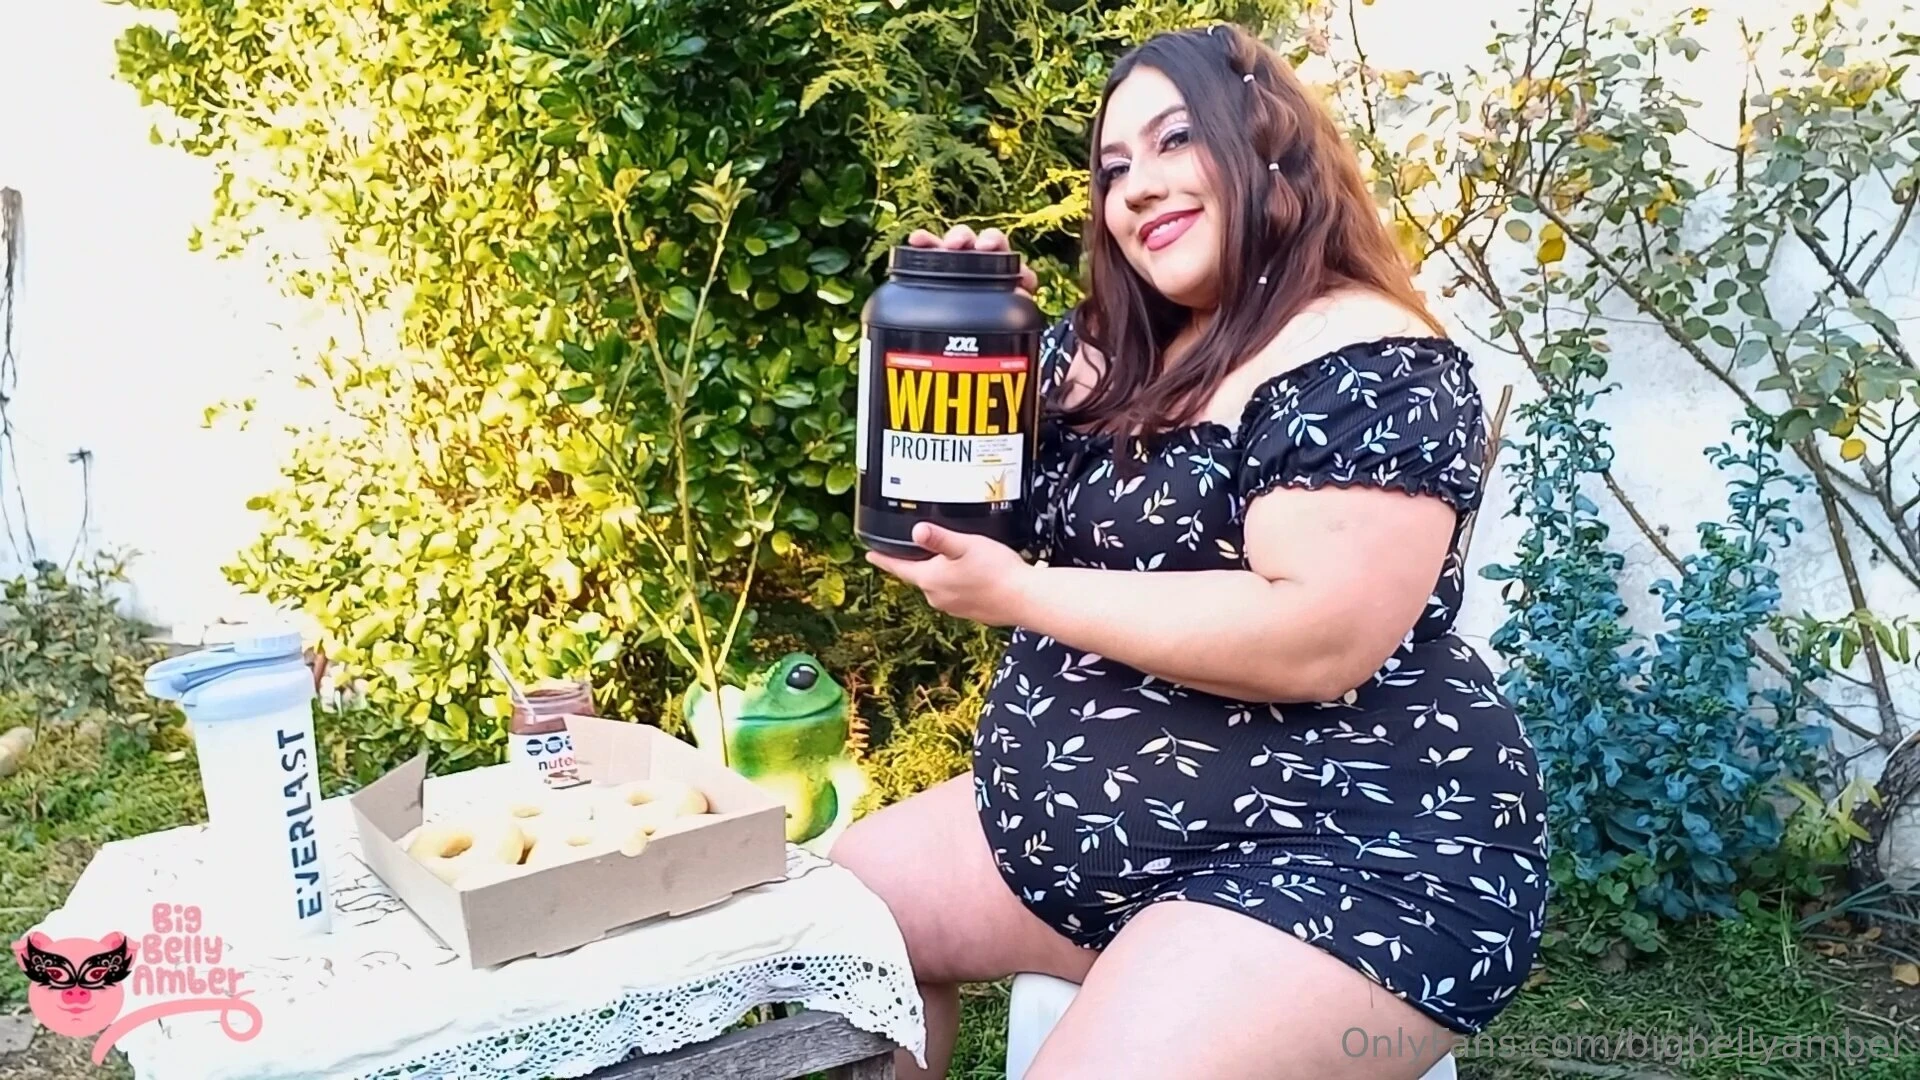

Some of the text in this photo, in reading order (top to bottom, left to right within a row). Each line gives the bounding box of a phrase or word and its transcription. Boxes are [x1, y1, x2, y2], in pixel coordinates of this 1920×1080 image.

[945, 336, 979, 352] XXL
[887, 368, 1027, 434] WHEY
[890, 435, 972, 463] PROTEIN
[538, 756, 576, 771] nute
[277, 729, 322, 919] EVERLAST
